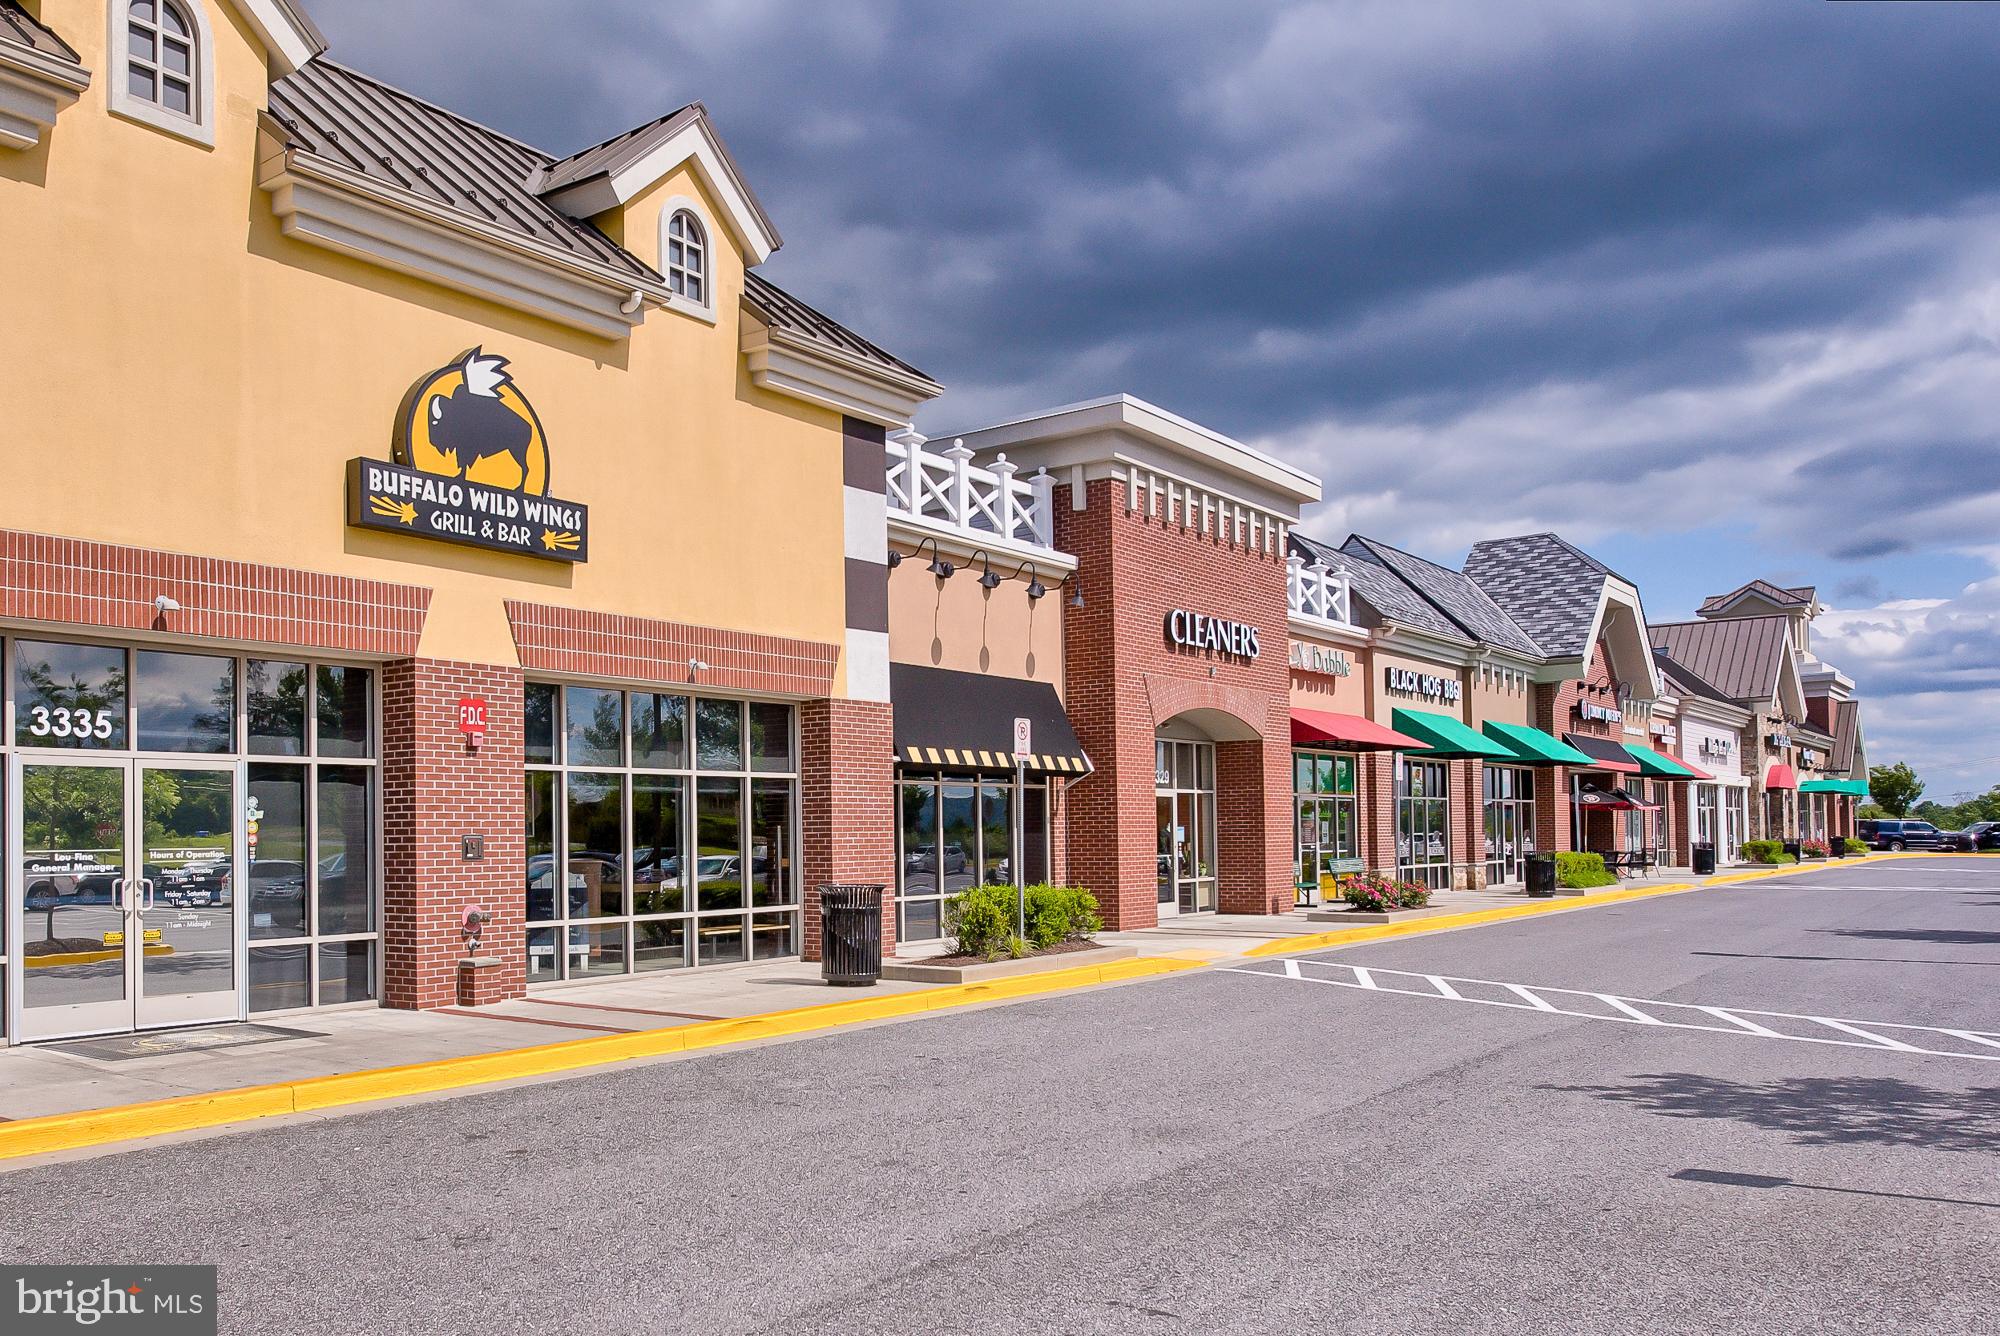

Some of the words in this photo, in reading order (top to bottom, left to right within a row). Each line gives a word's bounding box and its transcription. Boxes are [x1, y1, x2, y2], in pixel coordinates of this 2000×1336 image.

[369, 467, 463, 507] BUFFALO
[469, 487, 519, 518] WILD
[523, 499, 582, 531] WINGS
[430, 510, 476, 537] GRILL
[480, 519, 494, 540] &
[498, 523, 532, 547] BAR
[1169, 608, 1260, 658] CLEANERS
[1312, 645, 1351, 678] Bubble
[1390, 667, 1419, 693] BLACK
[1422, 673, 1442, 697] HOG
[1444, 678, 1460, 700] BBQ
[29, 706, 113, 739] 3335
[31, 863, 70, 872] General
[73, 862, 116, 872] Manager
[54, 853, 71, 861] Lou
[74, 852, 94, 861] Fino
[150, 851, 174, 859] Hours
[186, 850, 225, 860] Operation
[164, 890, 182, 898] Friday
[186, 889, 211, 897] Saturday
